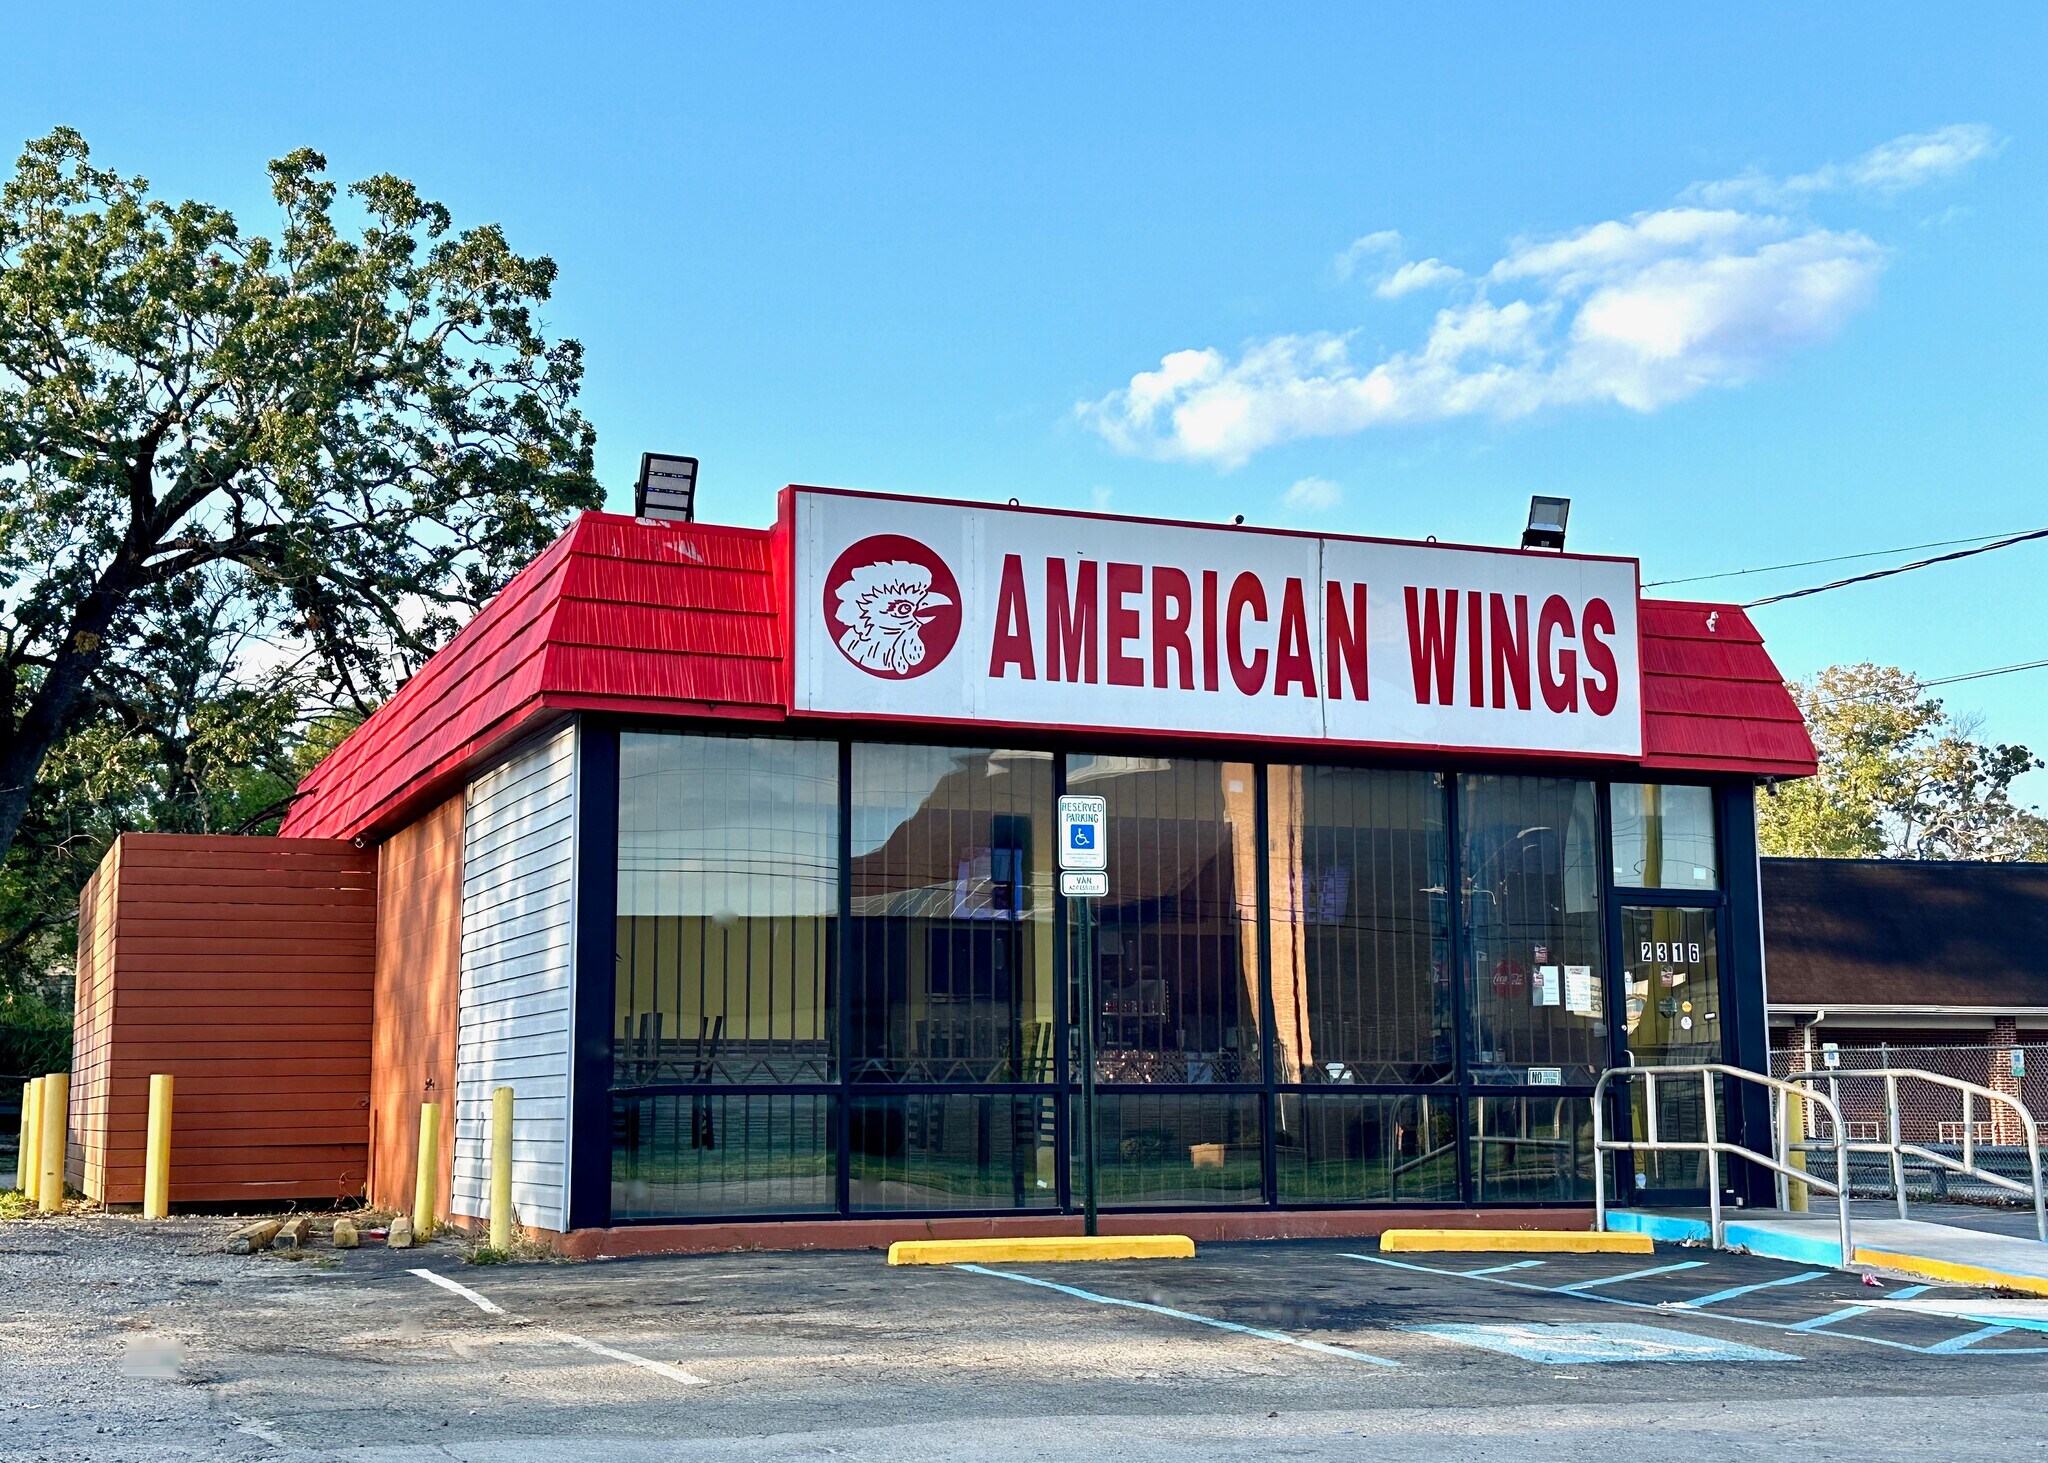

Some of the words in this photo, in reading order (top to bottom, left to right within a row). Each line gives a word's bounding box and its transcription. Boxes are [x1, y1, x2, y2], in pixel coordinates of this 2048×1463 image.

[990, 555, 1368, 700] AMERICAN
[1405, 587, 1618, 716] WINGS
[1061, 802, 1102, 812] RESERVED
[1066, 813, 1099, 823] PARKING
[1076, 876, 1092, 884] VAN
[1642, 943, 1698, 962] 2316
[1532, 1072, 1542, 1084] NO
